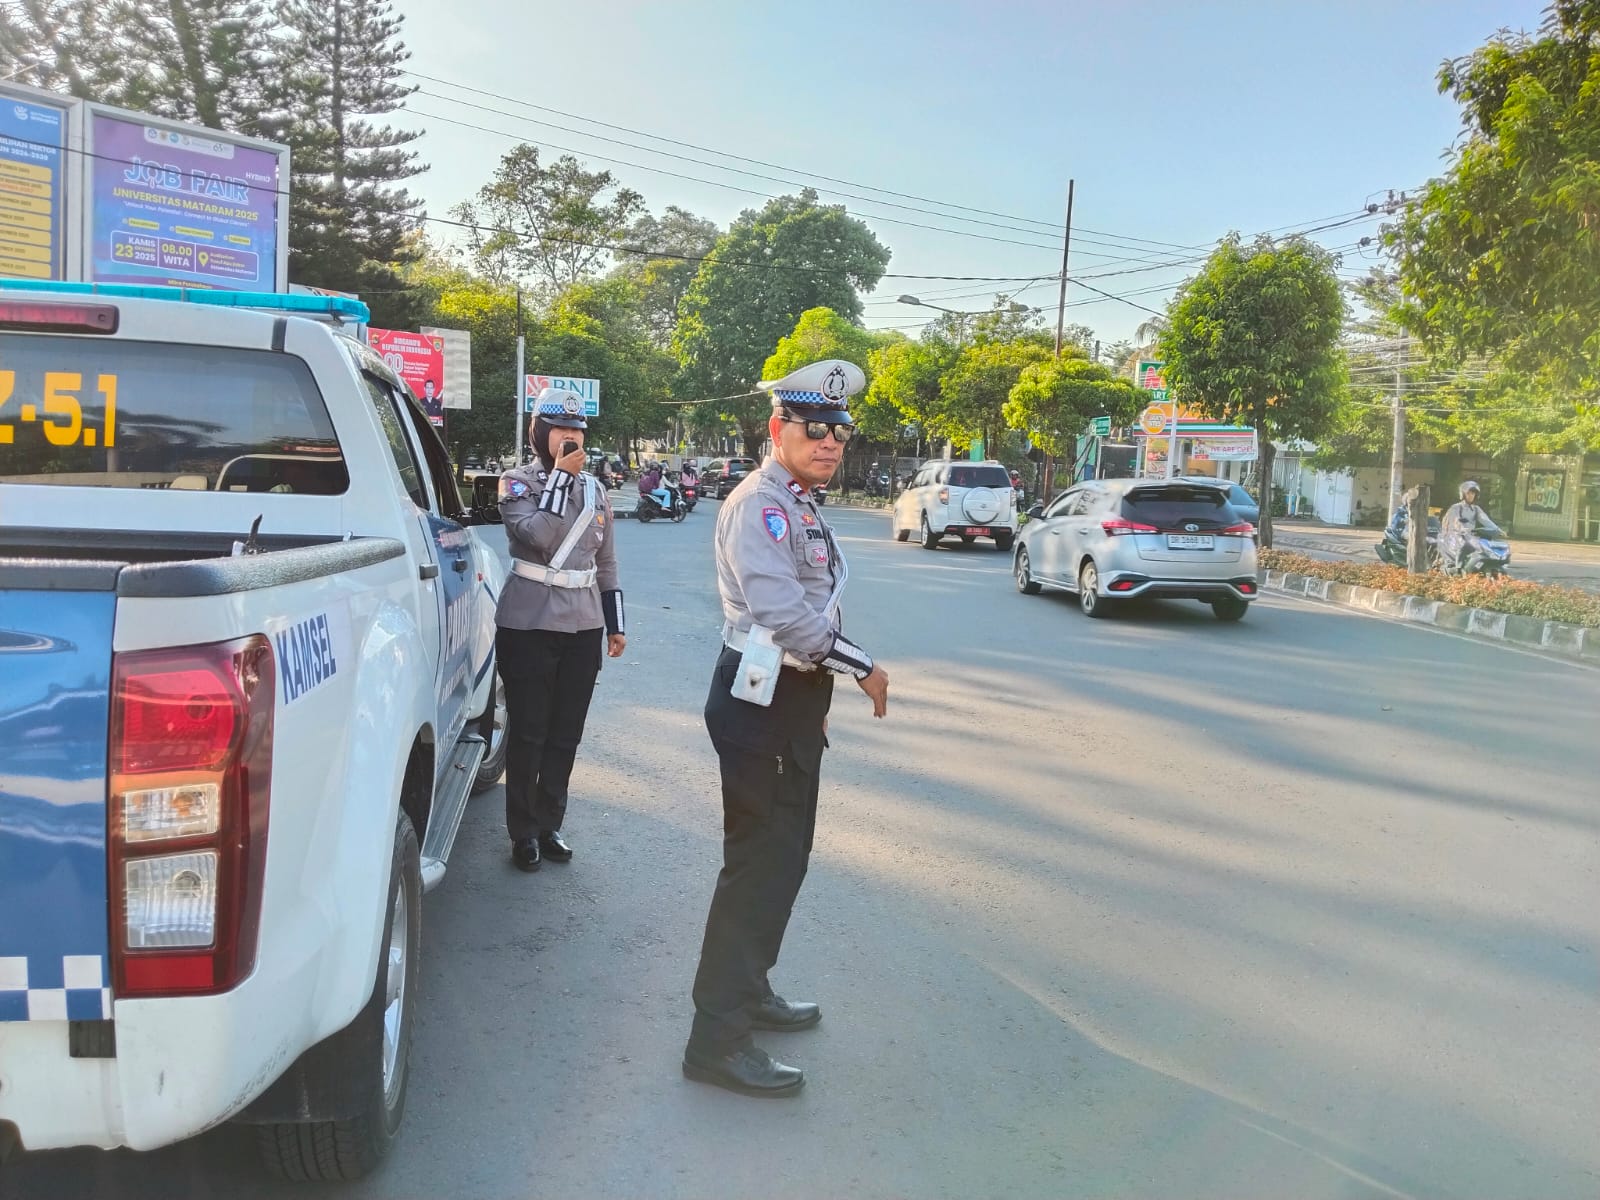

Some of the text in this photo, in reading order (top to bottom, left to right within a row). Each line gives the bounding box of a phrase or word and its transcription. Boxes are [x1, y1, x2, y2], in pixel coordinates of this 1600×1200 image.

[124, 156, 249, 202] JOB FAIR
[113, 187, 259, 221] UNIVERSITAS MATARAM 2025
[129, 236, 155, 247] KAMIS
[115, 244, 134, 258] 23
[162, 243, 192, 256] 08.00
[135, 251, 155, 262] 2025
[164, 256, 190, 267] WITA
[276, 613, 336, 705] KAMSEL
